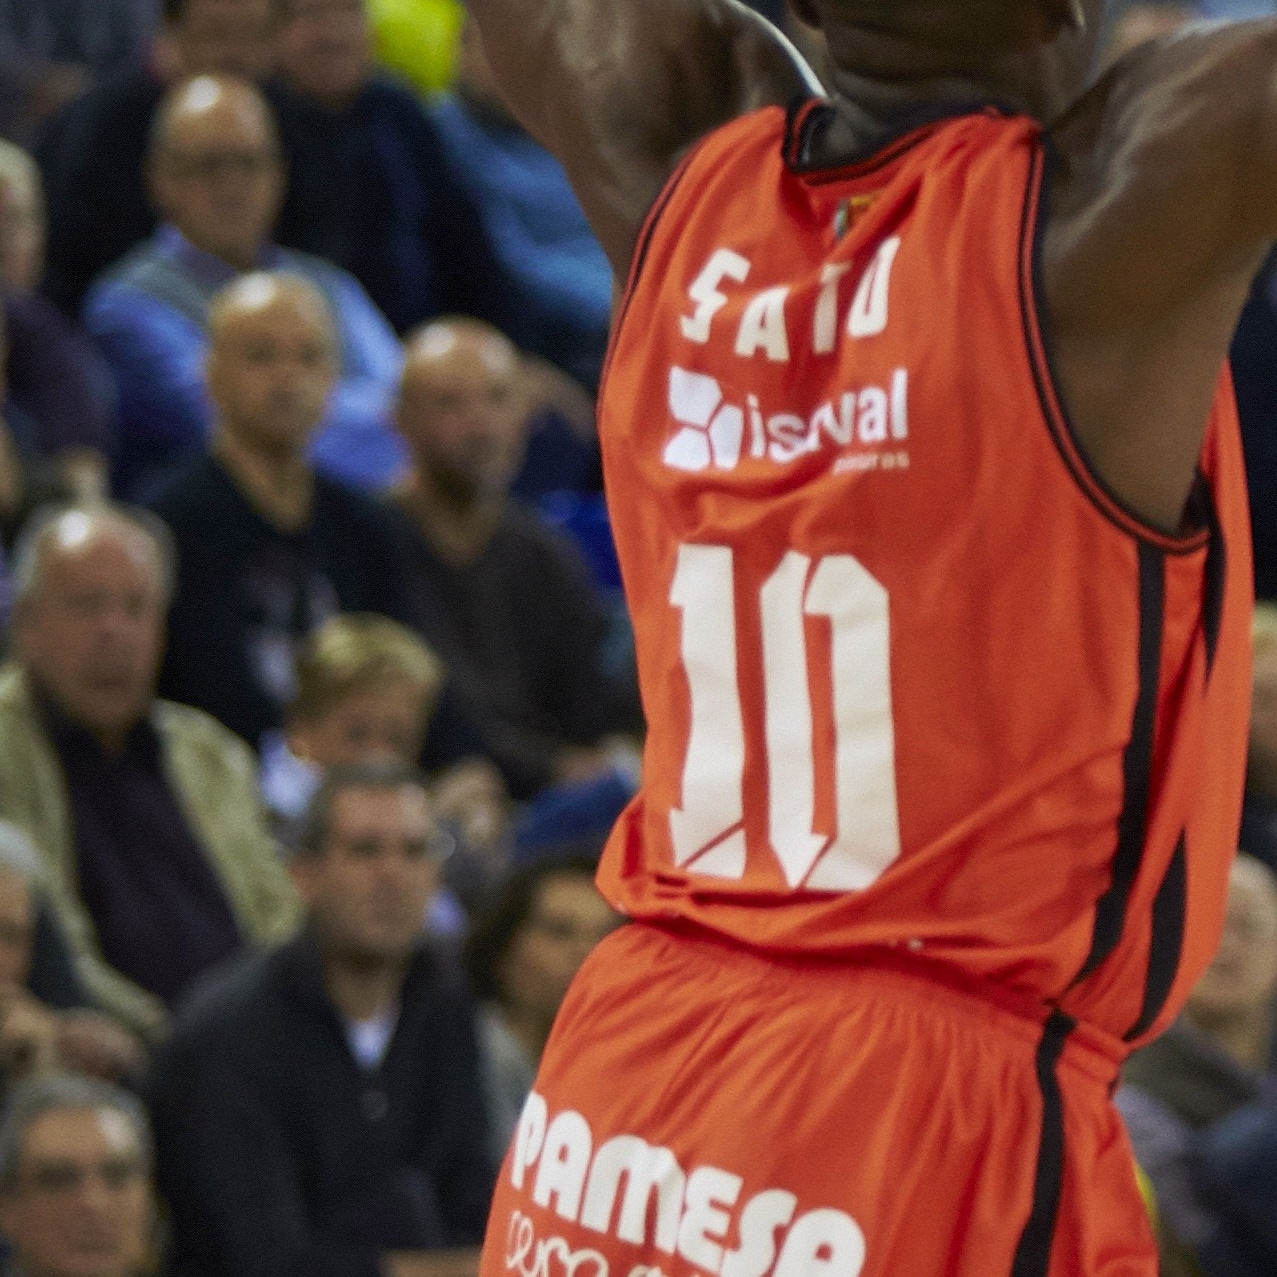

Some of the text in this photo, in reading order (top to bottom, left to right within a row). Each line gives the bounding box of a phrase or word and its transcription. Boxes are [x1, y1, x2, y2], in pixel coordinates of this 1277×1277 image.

[680, 235, 901, 363] SATO
[668, 542, 902, 891] 10
[510, 1089, 867, 1277] PAMESA
